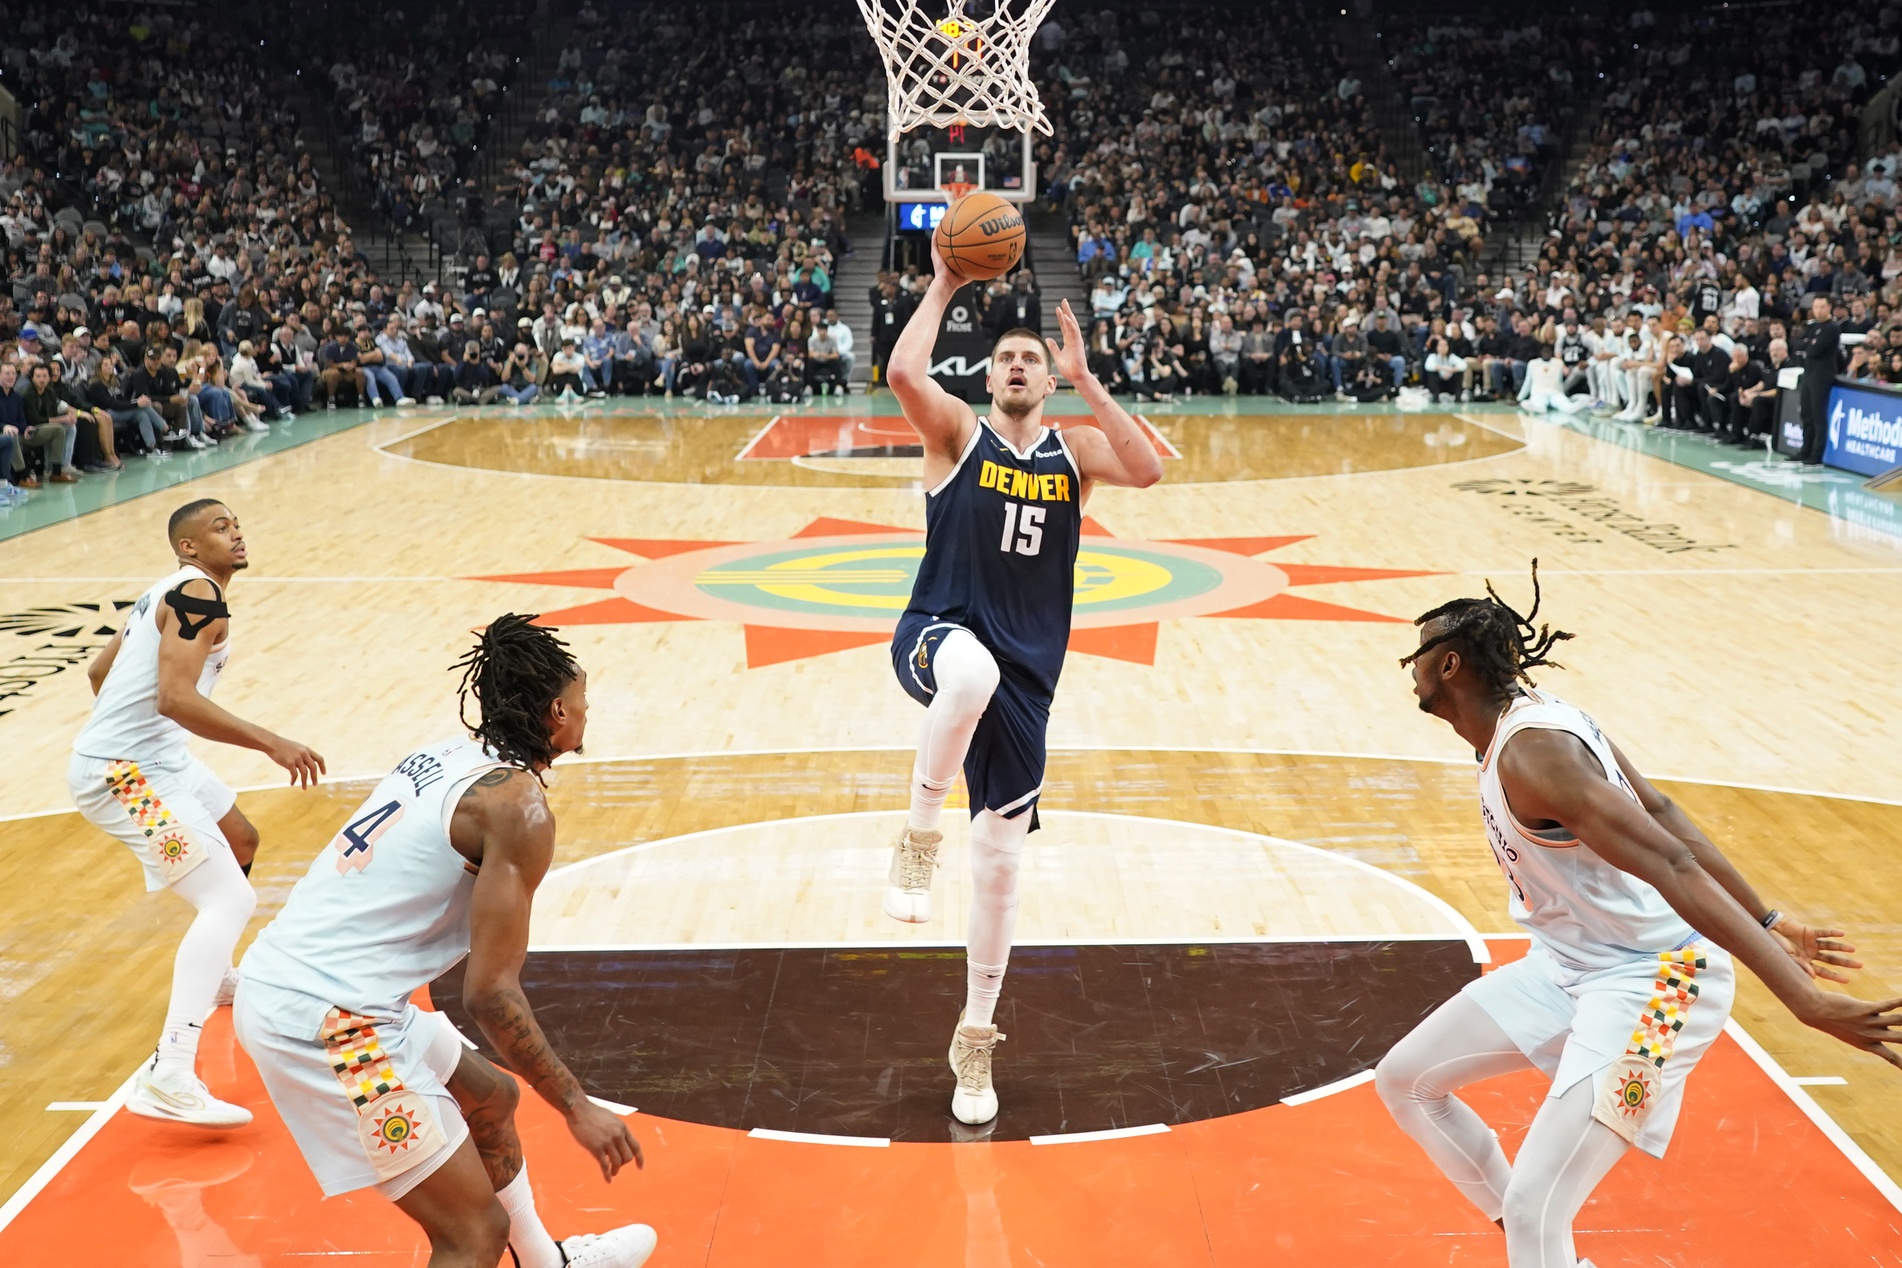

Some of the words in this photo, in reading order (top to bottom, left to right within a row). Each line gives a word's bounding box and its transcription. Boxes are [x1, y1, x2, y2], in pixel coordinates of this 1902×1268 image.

[1845, 439, 1896, 464] HEALTHCARE
[979, 460, 1070, 501] DENVER
[1000, 502, 1047, 556] 15
